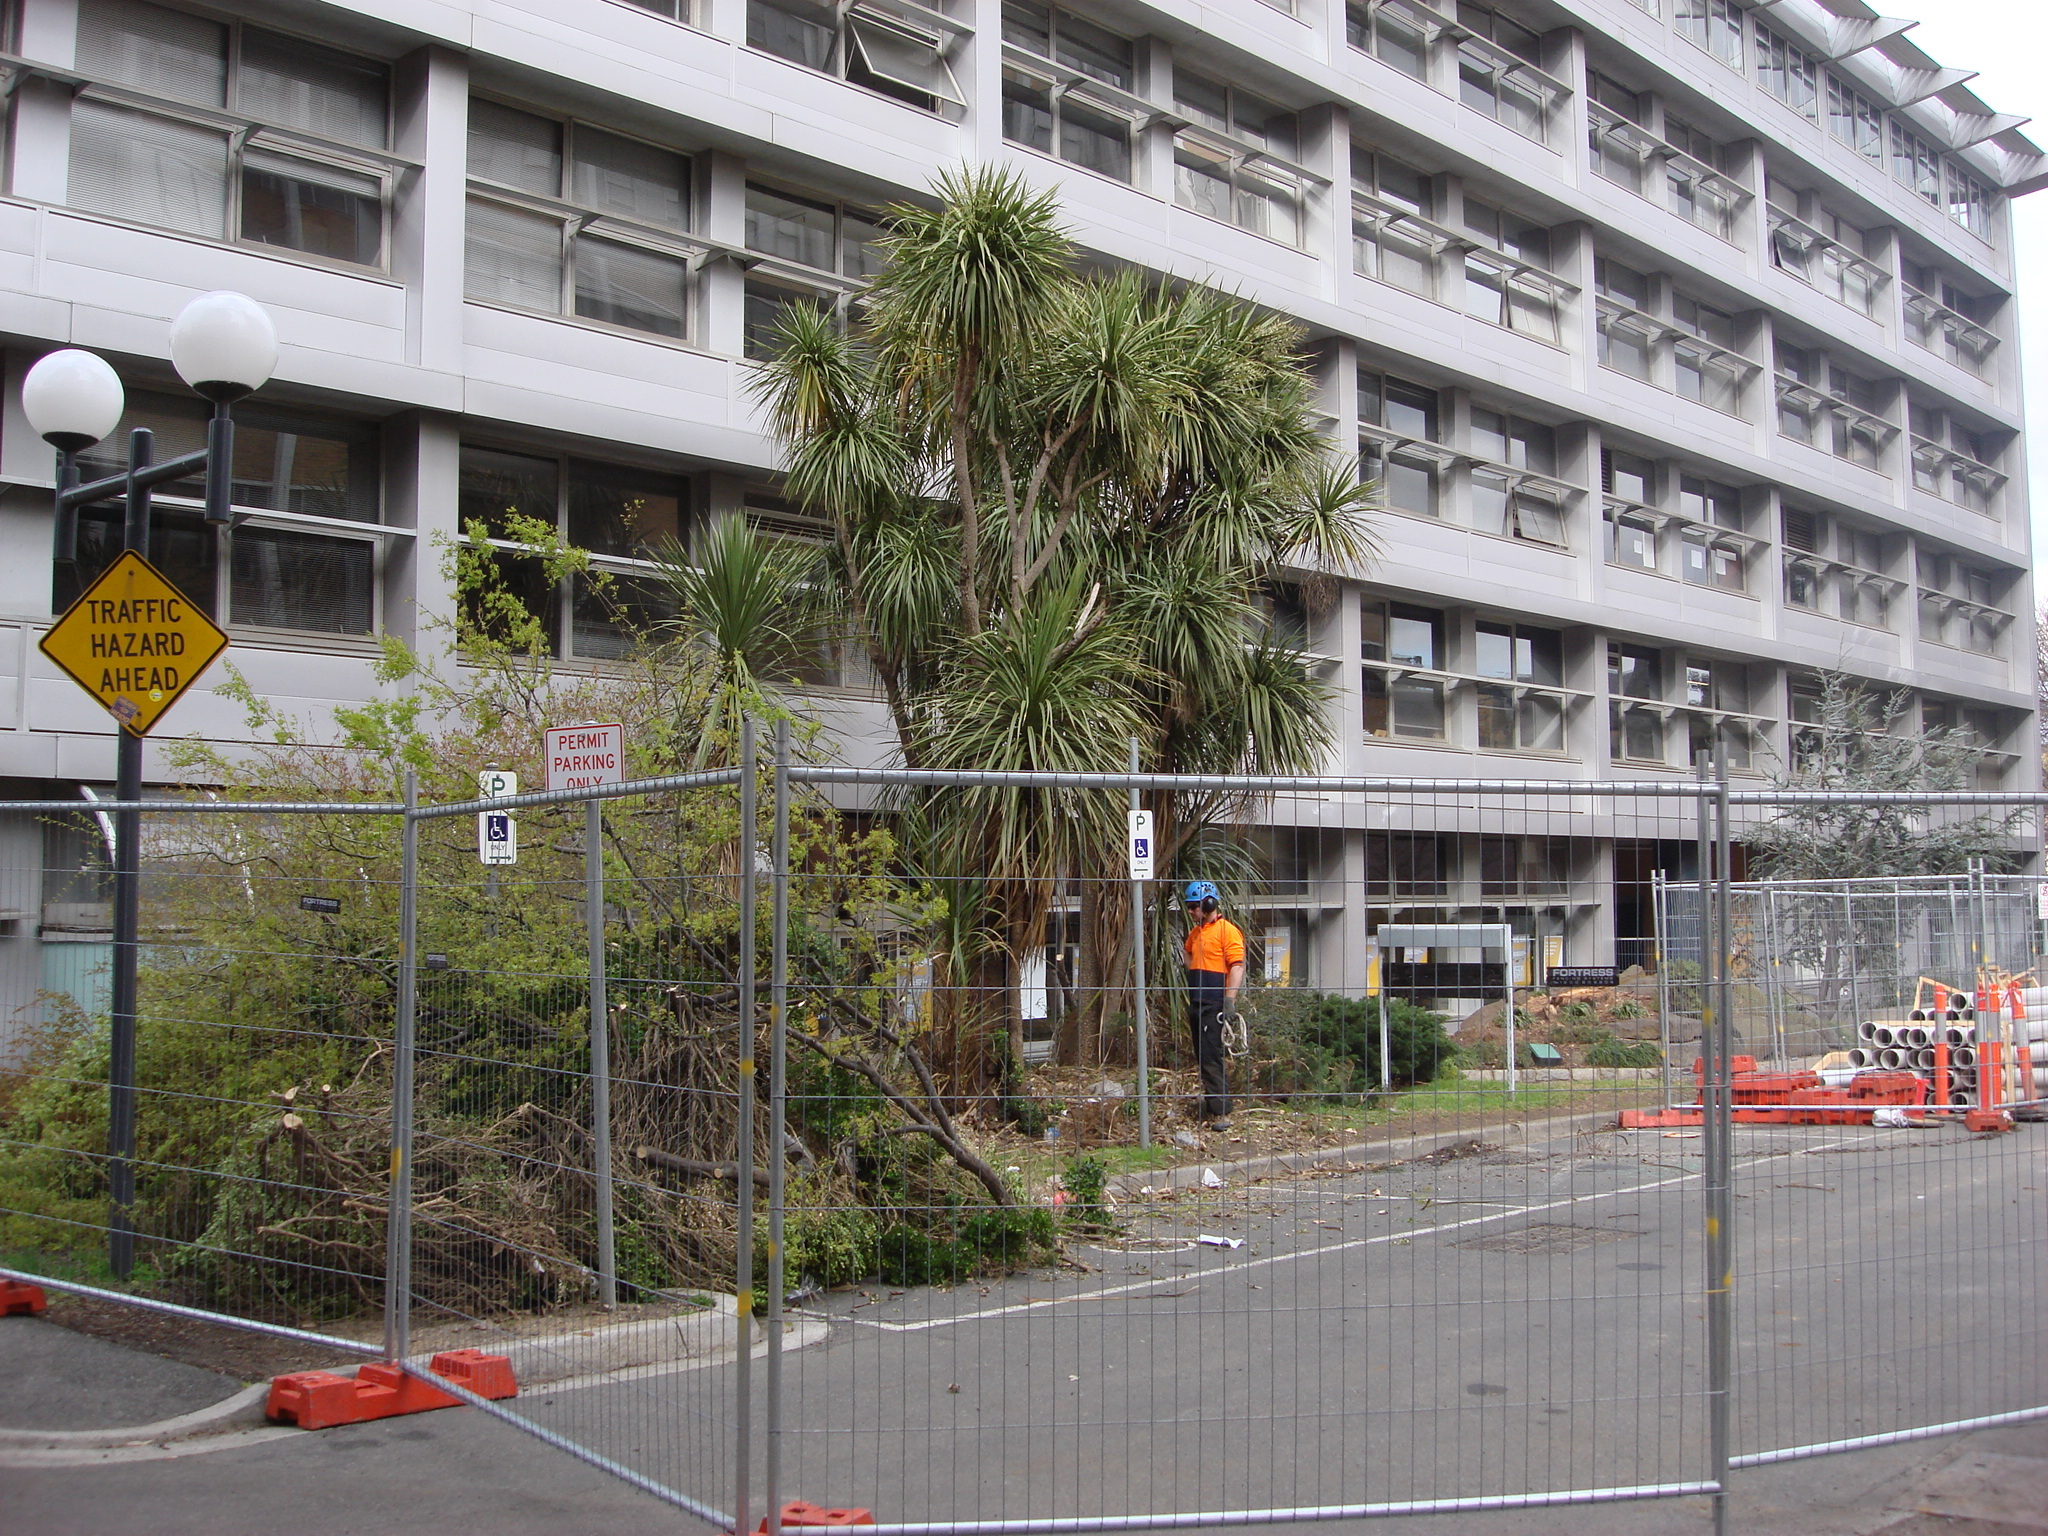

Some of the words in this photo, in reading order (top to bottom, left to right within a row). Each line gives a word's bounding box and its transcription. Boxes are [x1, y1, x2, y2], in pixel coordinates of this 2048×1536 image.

[87, 598, 181, 624] TRAFFIC
[91, 632, 185, 658] HAZARD
[100, 667, 179, 693] AHEAD
[558, 732, 609, 751] PERMIT
[554, 753, 615, 772] PARKING
[492, 777, 506, 798] P
[1136, 815, 1146, 831] P
[303, 897, 338, 907] FORTRESS
[1552, 968, 1614, 977] FORTRESS
